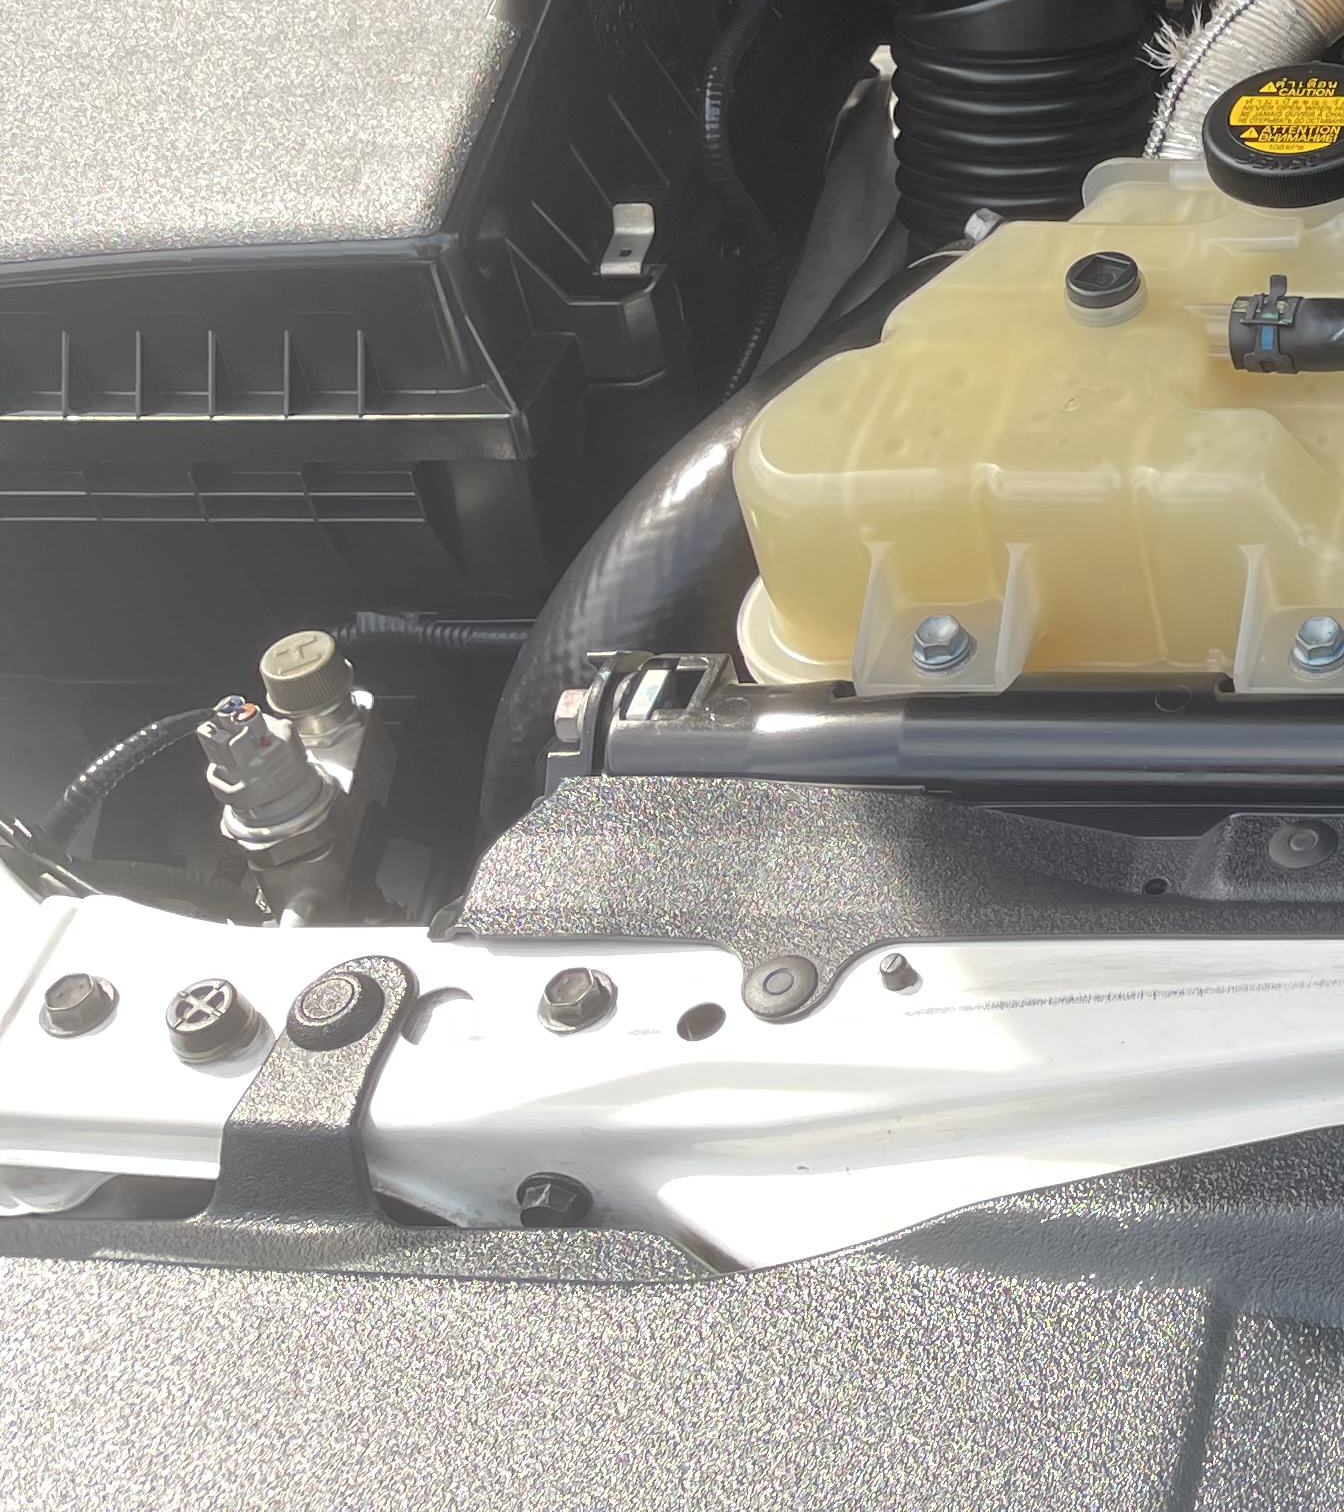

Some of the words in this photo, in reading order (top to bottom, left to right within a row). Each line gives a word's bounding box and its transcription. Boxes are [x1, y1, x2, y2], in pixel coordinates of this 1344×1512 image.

[1275, 77, 1338, 89] คำเตือน
[1278, 88, 1336, 97] CAUTION
[1260, 125, 1341, 134] ATTENTION
[1258, 133, 1339, 143] ВНИМАНИЕ!
